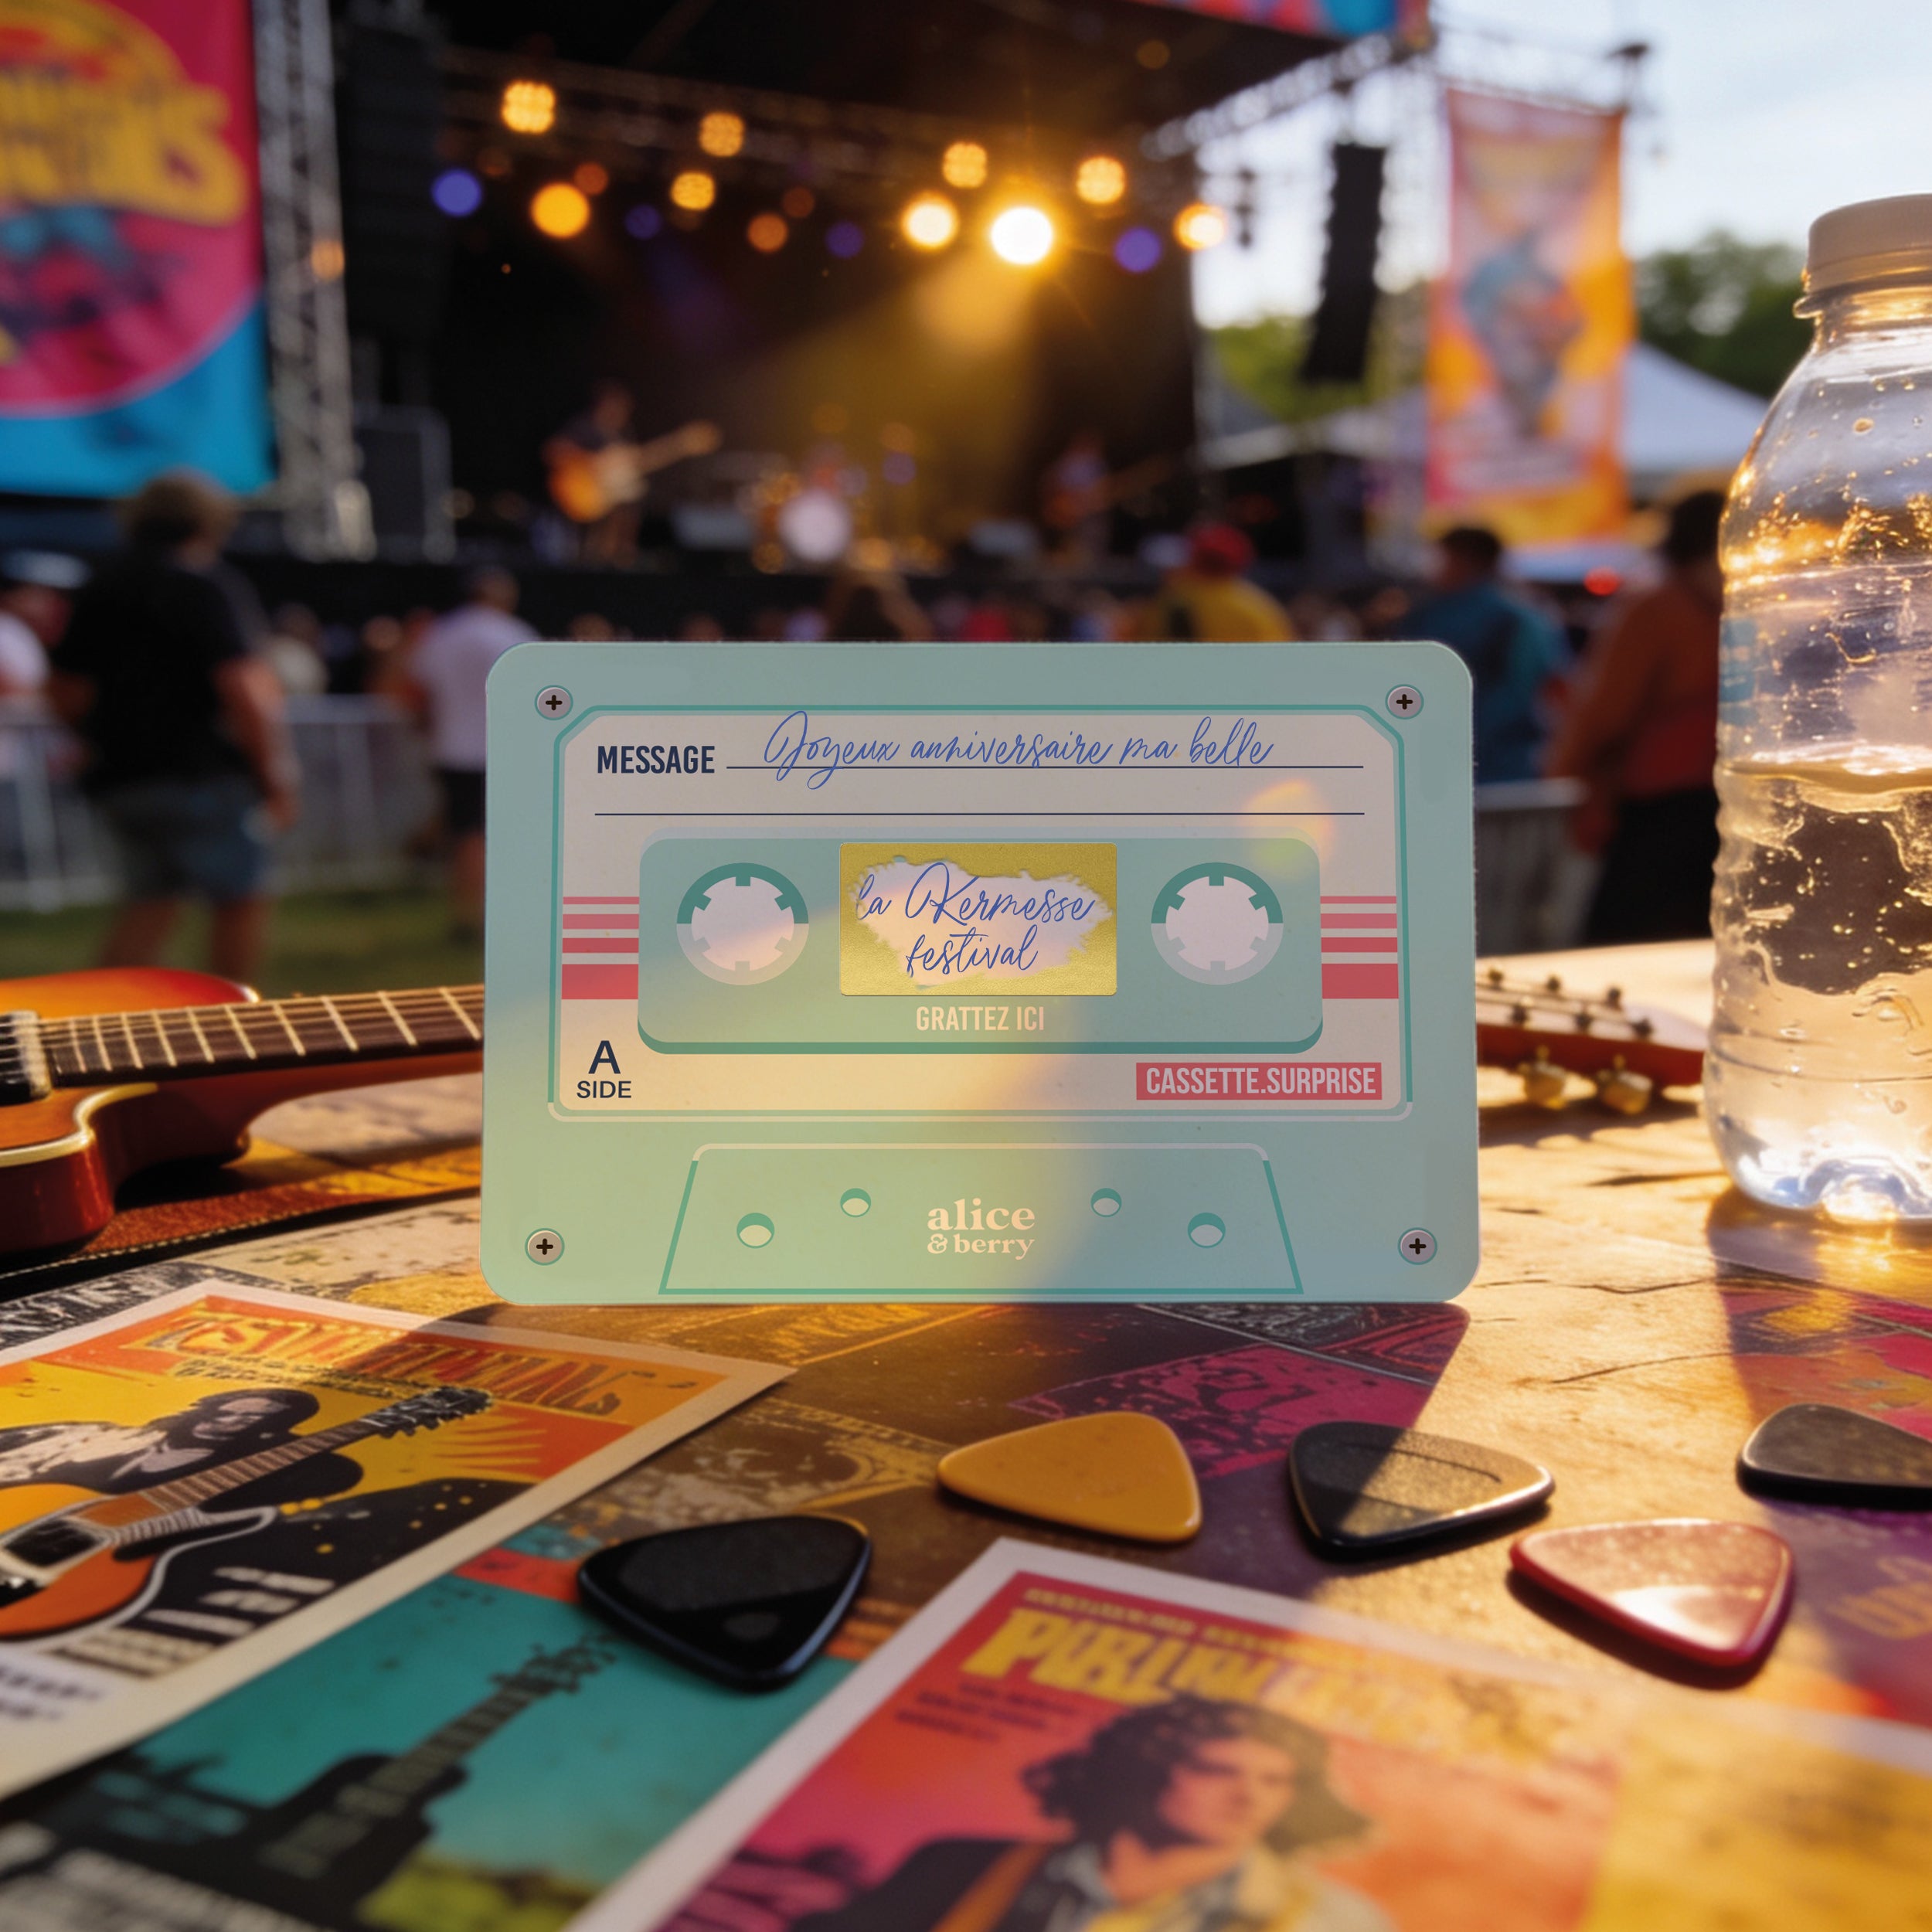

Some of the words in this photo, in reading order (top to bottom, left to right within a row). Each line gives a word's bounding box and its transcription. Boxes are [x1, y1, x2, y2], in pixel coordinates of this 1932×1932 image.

[597, 745, 716, 774] MESSAGE
[764, 710, 900, 790] Joyeux
[910, 730, 1114, 768] anniversaire
[1118, 737, 1178, 765] ma
[1189, 716, 1274, 766] belle
[855, 873, 893, 920] la
[904, 862, 1096, 926] Kermesse
[905, 924, 1039, 978] festival
[916, 1005, 1009, 1031] GRATTEZ
[1016, 1005, 1045, 1031] ICI
[587, 1039, 621, 1075] A
[576, 1080, 632, 1099] SIDE
[1145, 1067, 1376, 1094] CASSETTE.SURPRISE
[927, 1197, 1036, 1231] alice
[952, 1233, 1036, 1260] berry
